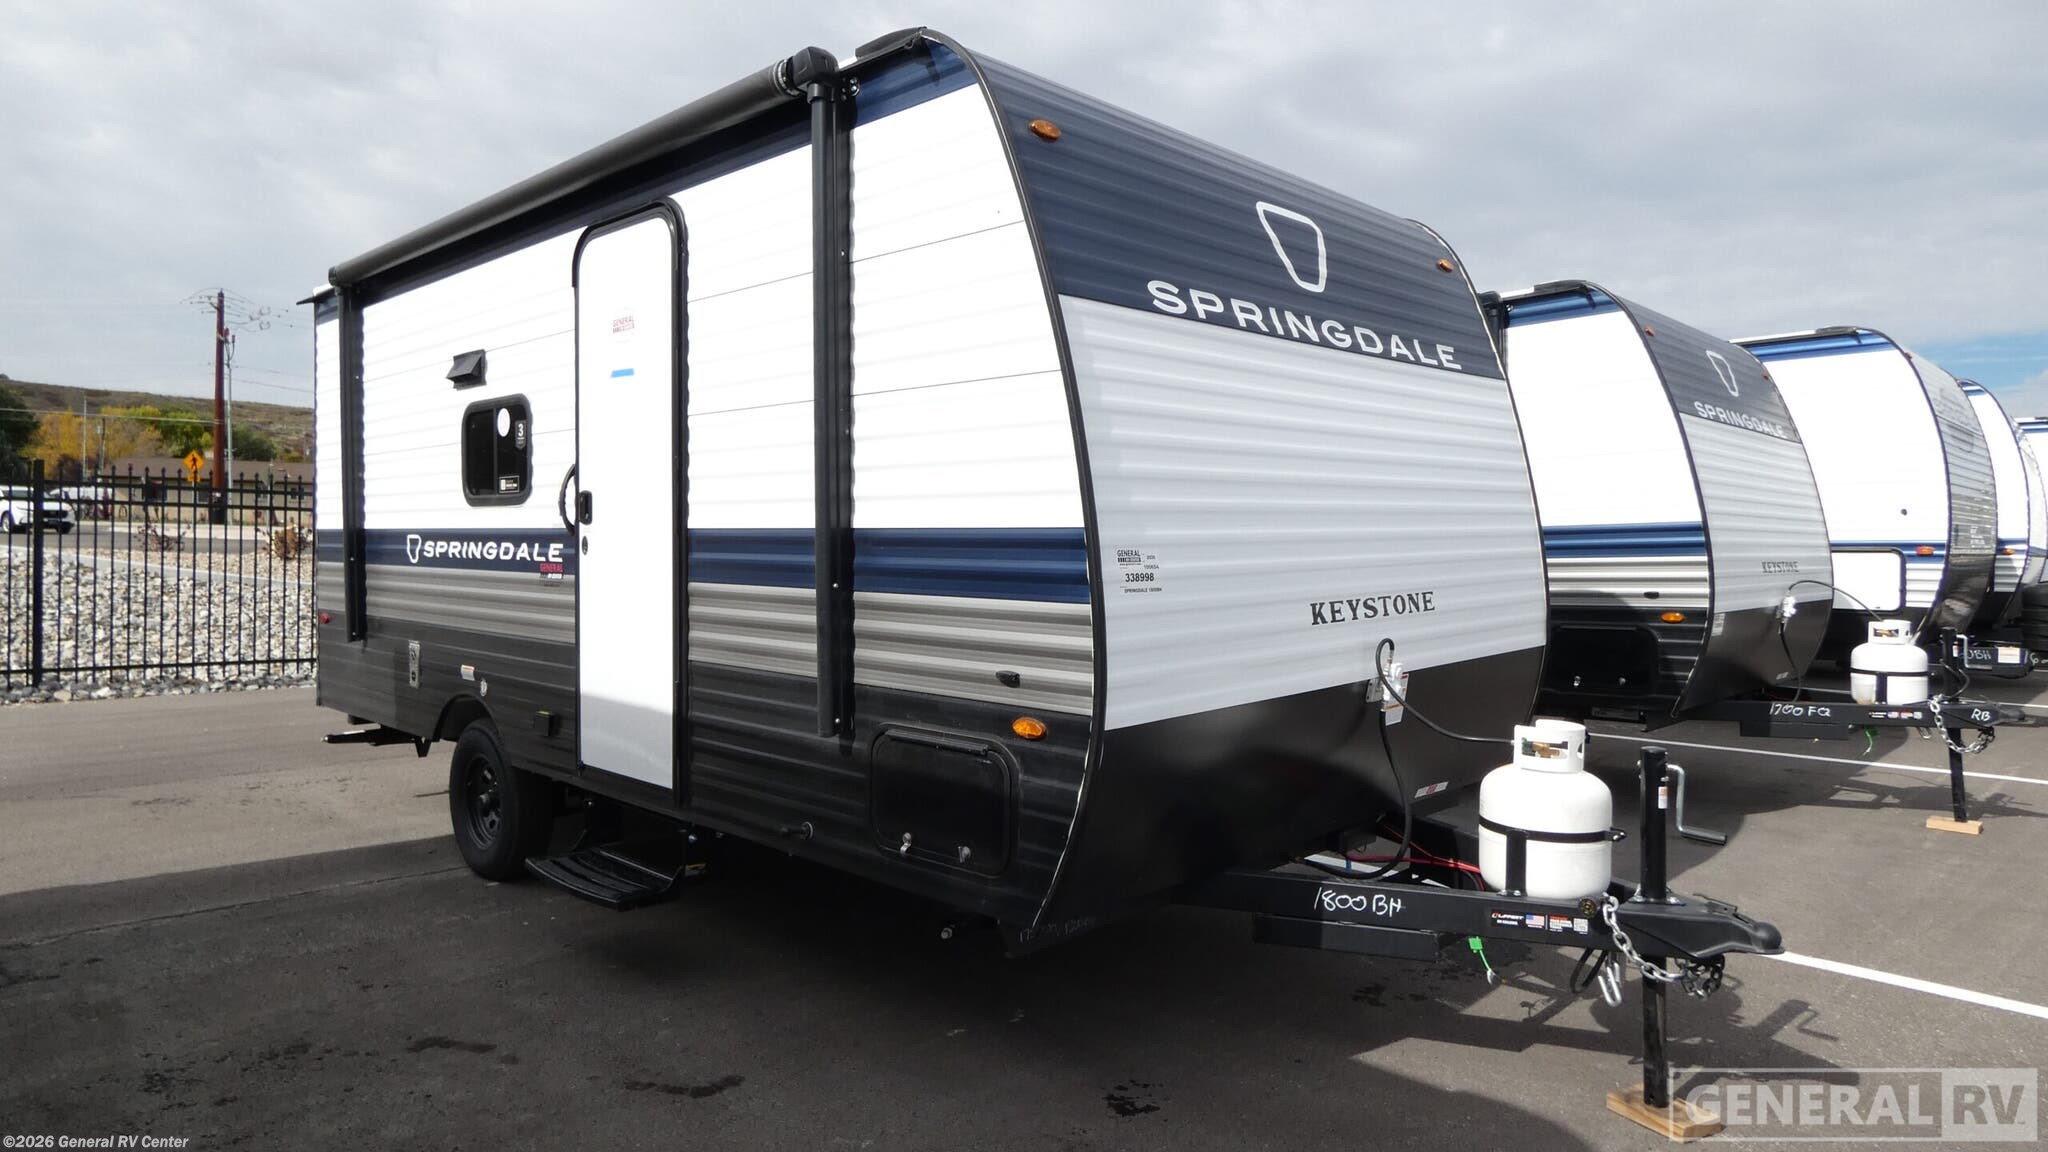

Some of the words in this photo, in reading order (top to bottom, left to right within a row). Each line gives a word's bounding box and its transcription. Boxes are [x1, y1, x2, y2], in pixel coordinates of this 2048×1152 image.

[1147, 279, 1463, 370] SPRINGDALE
[1693, 400, 1787, 439] SPRINGDALE
[423, 541, 564, 563] SPRINGDALE
[1116, 549, 1141, 557] GENERAL
[1125, 572, 1155, 582] 338998
[1309, 591, 1436, 626] KEYSTONE
[1971, 708, 1991, 721] RB
[1314, 886, 1367, 912] 1800
[1372, 894, 1403, 917] BH
